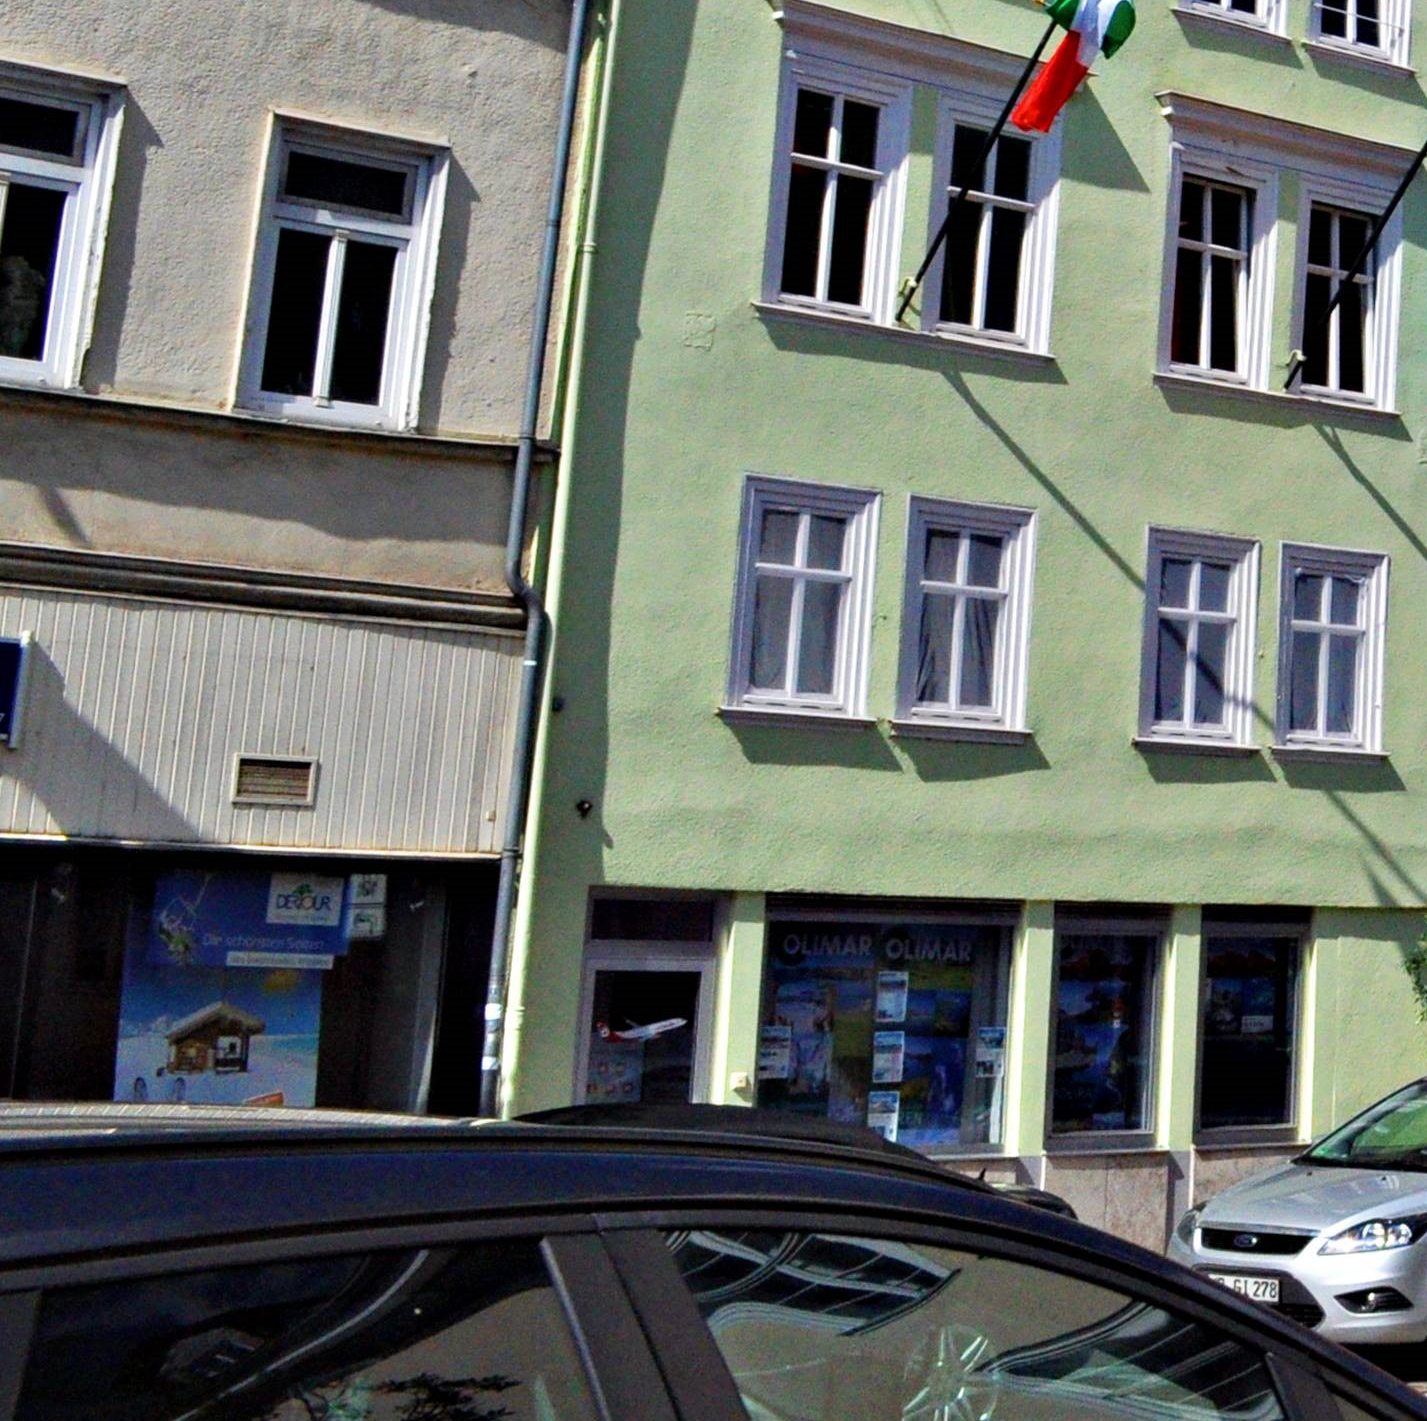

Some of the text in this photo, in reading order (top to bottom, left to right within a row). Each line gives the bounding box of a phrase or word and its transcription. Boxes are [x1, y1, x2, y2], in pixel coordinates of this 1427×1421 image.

[784, 933, 873, 956] OLIMAR
[885, 938, 973, 962] OLIMAR
[1253, 1280, 1278, 1299] 278
